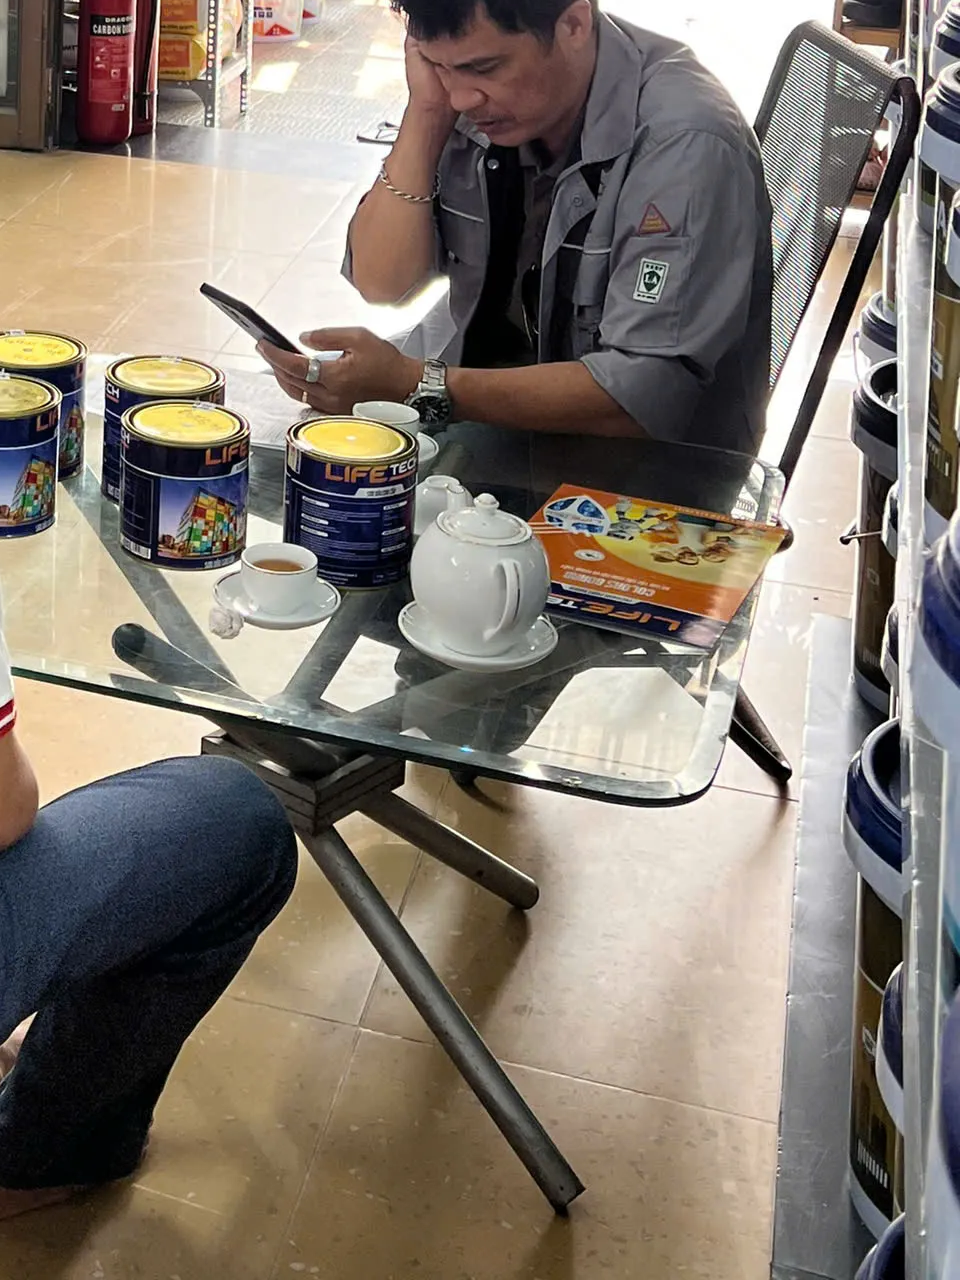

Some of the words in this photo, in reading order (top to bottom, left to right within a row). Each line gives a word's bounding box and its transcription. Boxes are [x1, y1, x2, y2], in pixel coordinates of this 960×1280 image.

[92, 24, 122, 35] CARBON
[106, 382, 120, 399] CH
[36, 407, 59, 432] LIF
[205, 440, 249, 466] LIFE
[325, 462, 389, 484] LIFE
[389, 457, 417, 476] TEC
[580, 602, 681, 631] LIFE
